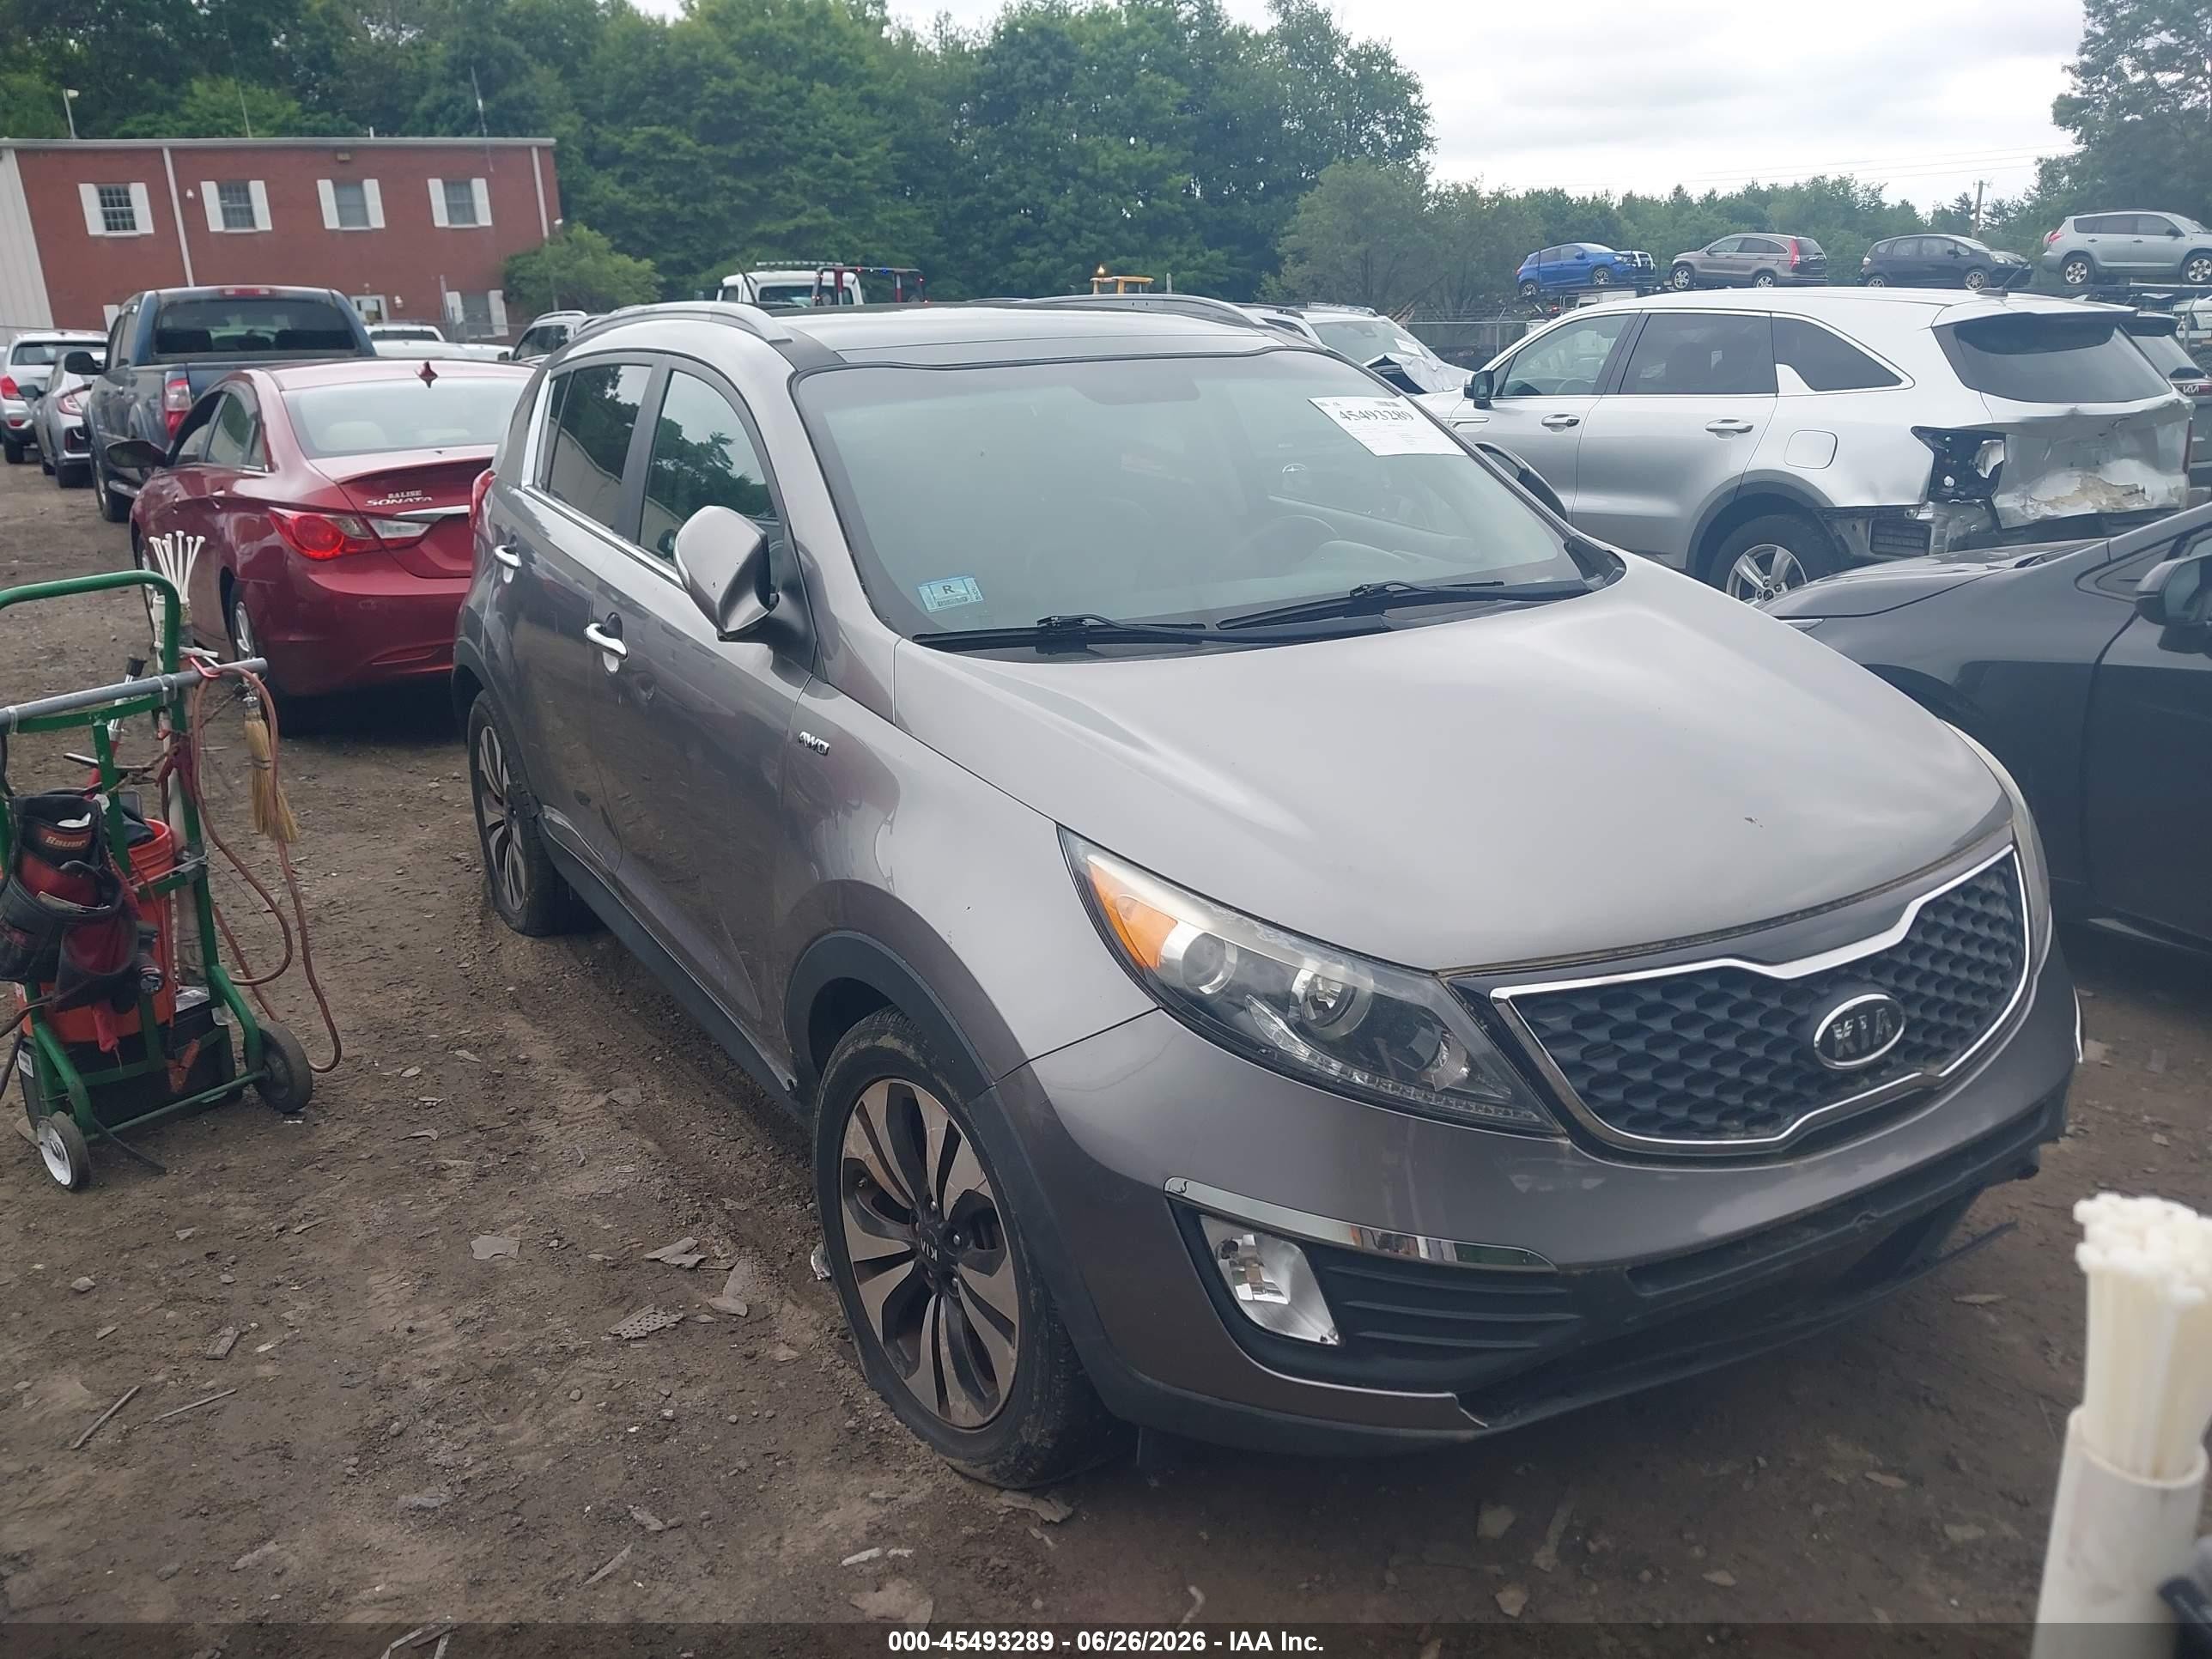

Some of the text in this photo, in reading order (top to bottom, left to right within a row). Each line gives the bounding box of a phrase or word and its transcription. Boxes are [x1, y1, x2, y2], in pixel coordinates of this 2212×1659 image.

[1339, 410, 1414, 421] 45493289
[364, 496, 433, 507] SONATA
[942, 585, 955, 594] R
[798, 731, 830, 756] AWD
[1832, 1007, 1894, 1058] KIA
[920, 1237, 938, 1262] KIA
